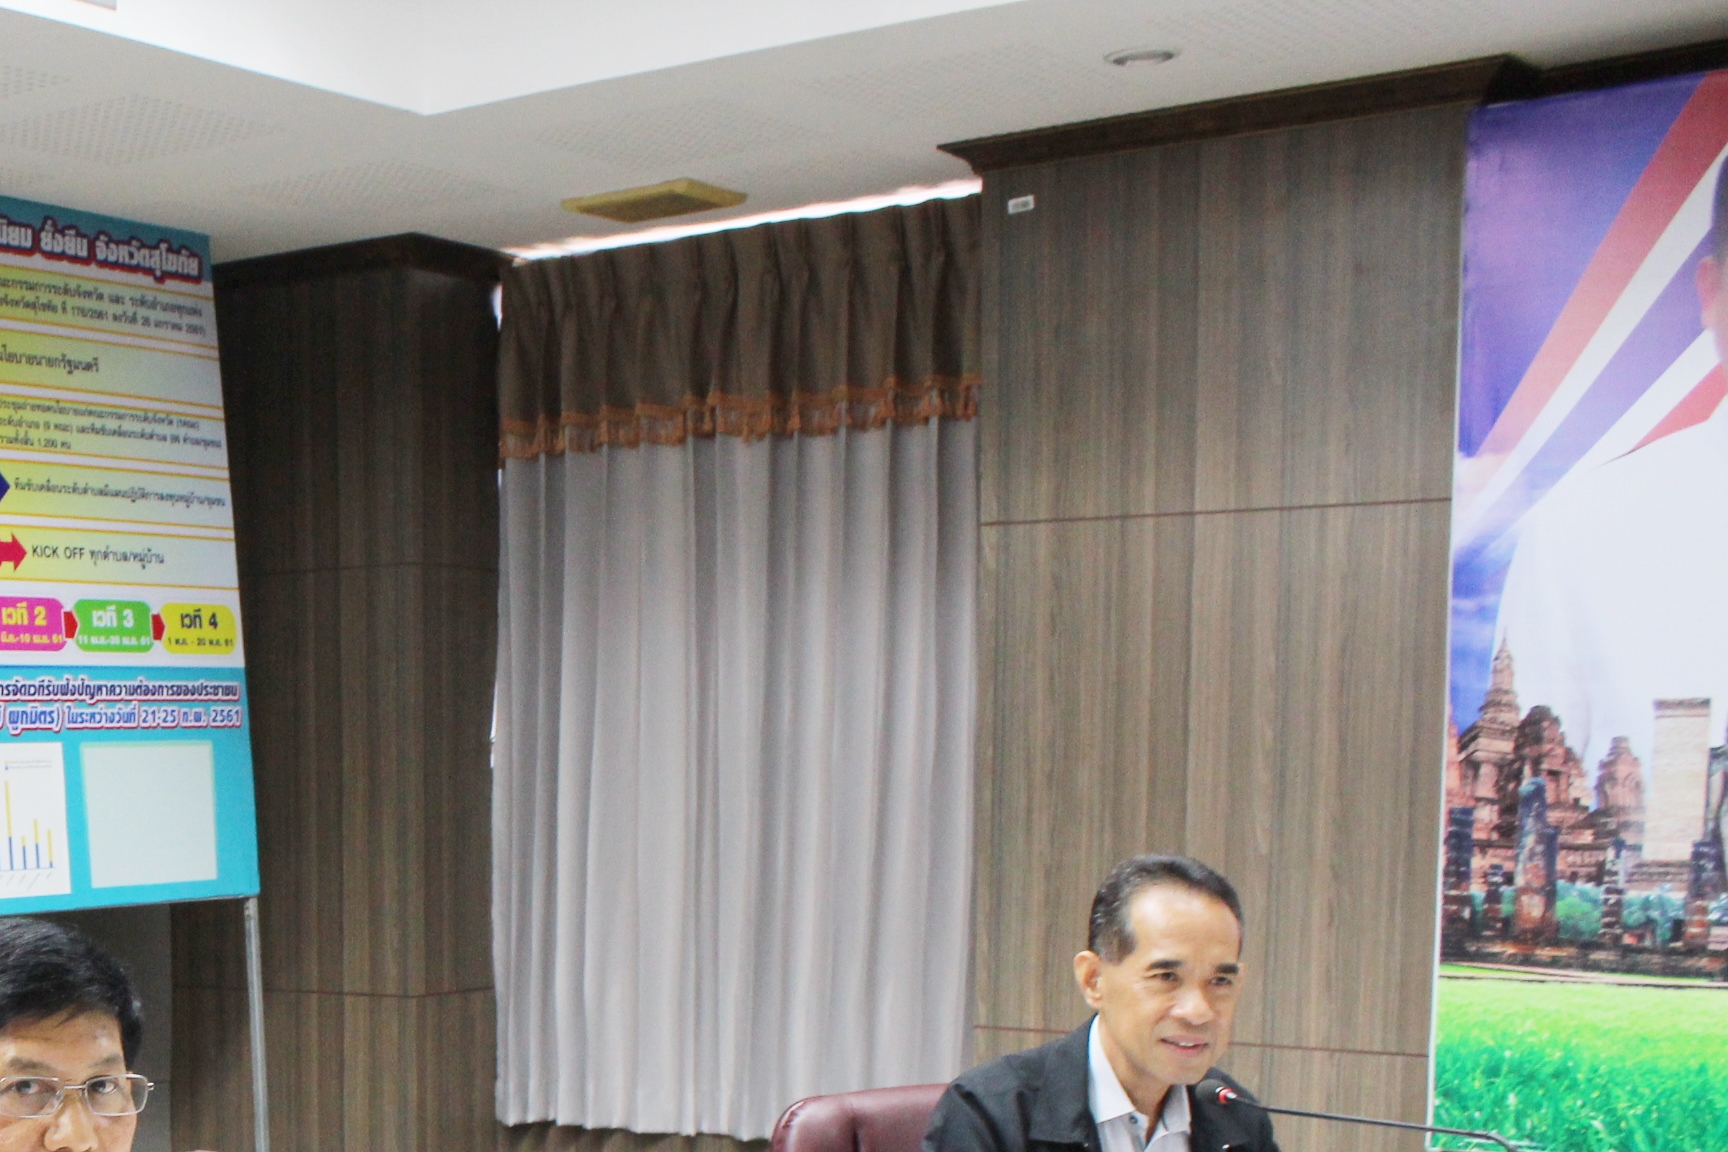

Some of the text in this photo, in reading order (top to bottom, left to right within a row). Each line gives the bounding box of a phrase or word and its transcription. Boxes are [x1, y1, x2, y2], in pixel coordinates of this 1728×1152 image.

[39, 220, 89, 259] ยั่งยืน
[94, 234, 200, 278] จังหวัดสุโขทัย
[32, 544, 60, 560] KICK
[64, 545, 85, 561] OFF
[1, 601, 48, 626] เวที 2
[92, 604, 135, 629] เวที 3
[180, 608, 219, 630] เวที 4
[8, 706, 61, 731] ผูกมิตร)
[66, 703, 137, 726] ในระหว่างวันที่
[142, 708, 177, 724] 21-25
[182, 710, 206, 724] ก.พ.
[212, 708, 241, 724] 2561
